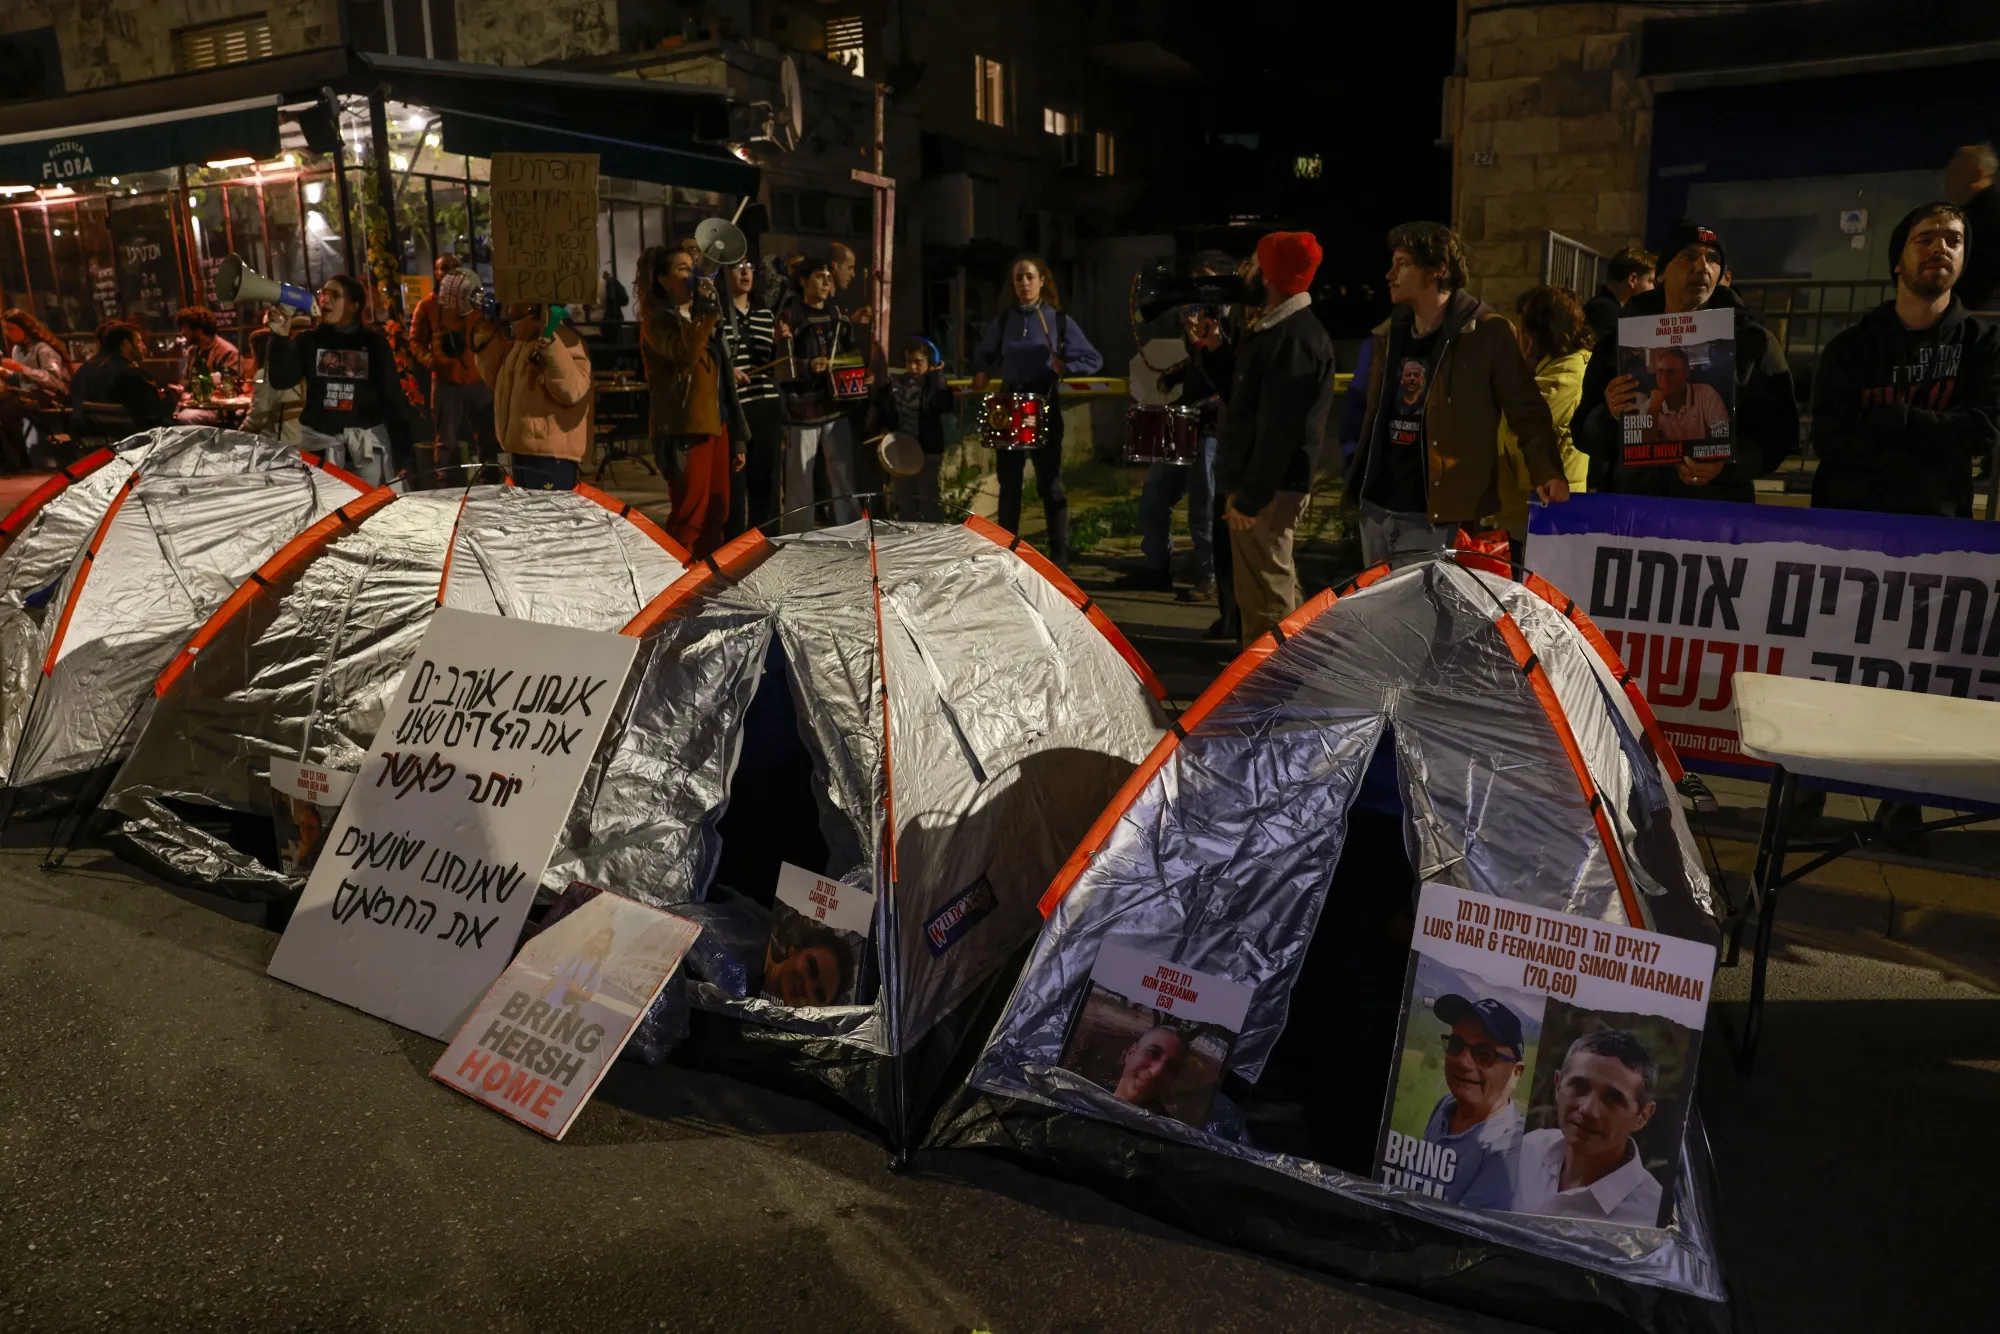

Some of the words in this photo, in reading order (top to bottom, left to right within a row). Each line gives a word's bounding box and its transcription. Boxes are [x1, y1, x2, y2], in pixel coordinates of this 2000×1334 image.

[42, 156, 93, 180] FLORA
[1656, 327, 1672, 336] OHAD
[1673, 326, 1684, 334] BEN
[1686, 325, 1696, 333] AMI
[1624, 414, 1653, 430] BRING
[1624, 430, 1643, 444] HIM
[1624, 445, 1651, 460] HOME
[1654, 441, 1684, 458] NOW!
[1590, 546, 1748, 630] אותם
[512, 674, 607, 716] אנחנו
[444, 710, 530, 751] הילדים
[532, 719, 583, 756] את
[421, 848, 526, 904] שאנחנו
[332, 878, 437, 934] החמאס
[808, 890, 828, 907] CARMEL
[828, 898, 838, 910] GAT
[1456, 900, 1490, 925] מרמן
[437, 912, 500, 949] את
[1494, 908, 1532, 934] סימון
[1535, 917, 1588, 948] ופרננדו
[1592, 930, 1612, 954] הר
[1615, 935, 1661, 964] לואיס
[1423, 916, 1454, 940] LUIS
[1456, 924, 1484, 948] HAR
[1488, 932, 1498, 952] &
[1500, 934, 1576, 970] FERNANDO
[1579, 953, 1628, 984] SIMON
[1630, 965, 1704, 1002] MARMAN
[1142, 975, 1159, 990] RON
[1158, 981, 1198, 1004] BENJAMIN
[1156, 966, 1180, 983] בנימין
[1180, 974, 1192, 988] רון
[1523, 964, 1577, 998] (70,60)
[1156, 994, 1174, 1010] (53)
[500, 990, 605, 1053] BRING
[478, 1020, 585, 1087] HERSH
[456, 1049, 564, 1120] HOME
[1384, 1130, 1457, 1182] BRING
